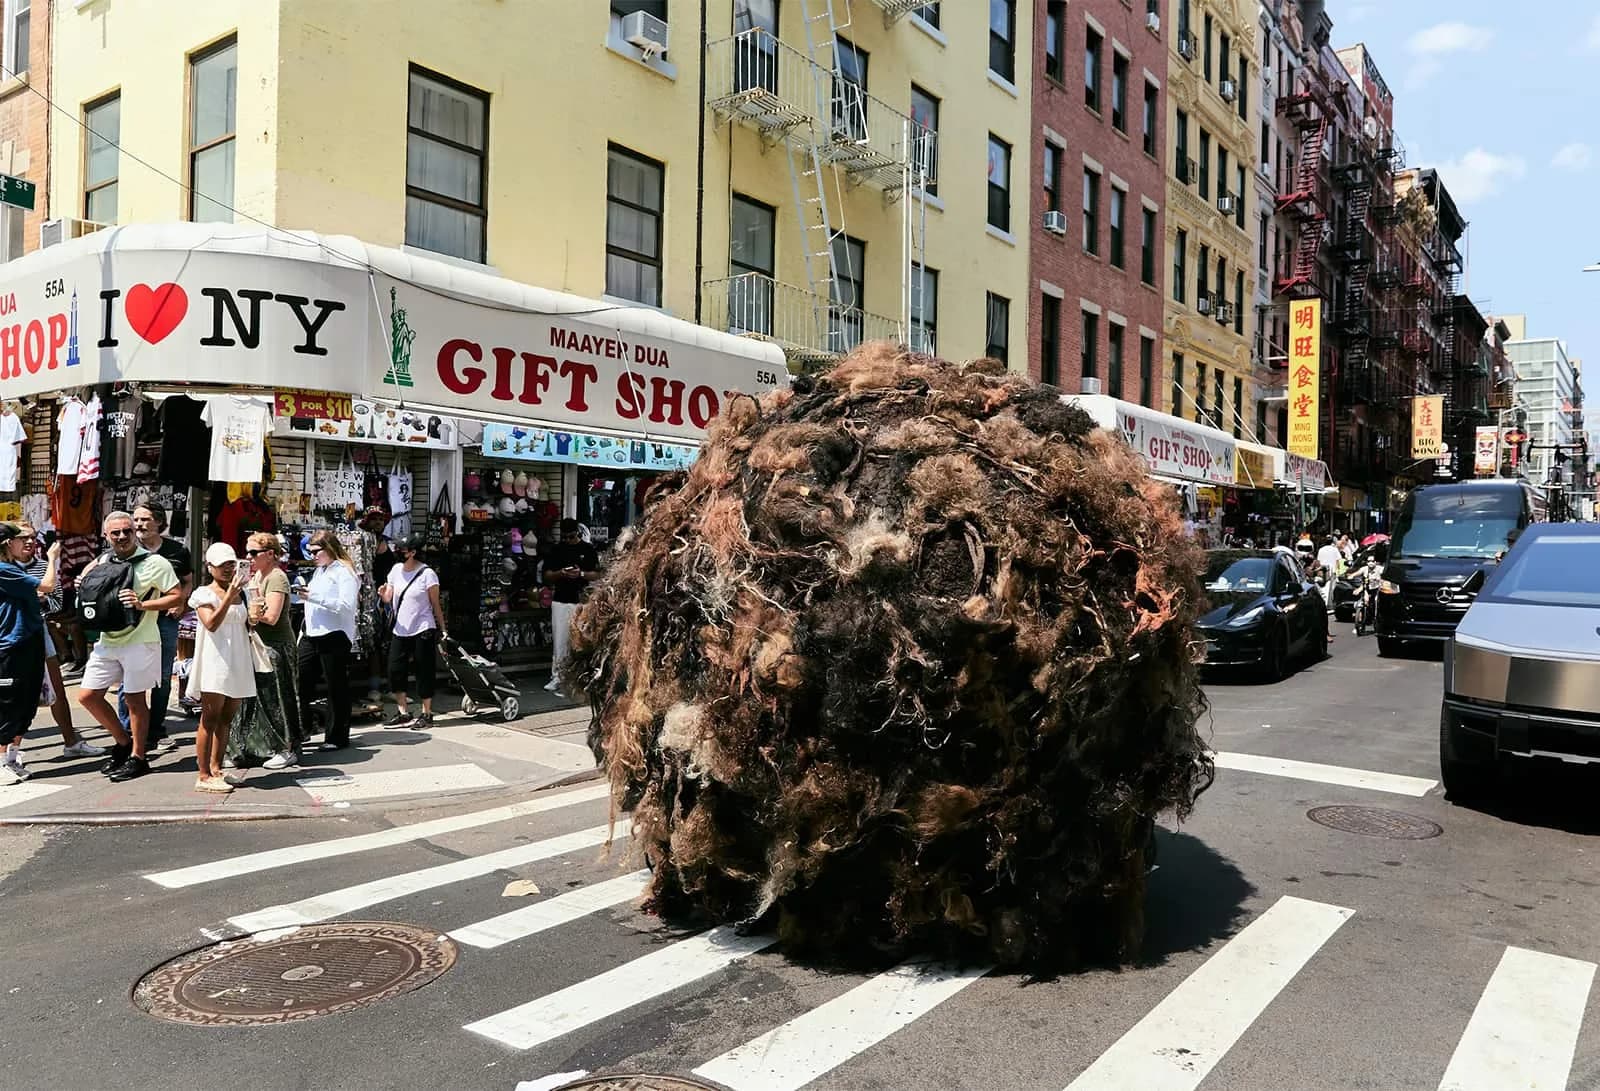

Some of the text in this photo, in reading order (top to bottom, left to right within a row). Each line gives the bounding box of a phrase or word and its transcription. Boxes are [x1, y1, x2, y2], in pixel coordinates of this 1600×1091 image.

[15, 181, 28, 191] St
[45, 278, 65, 298] 55A
[97, 287, 346, 356] I NY
[0, 313, 67, 380] HOP
[549, 326, 669, 369] MAAYER DUA
[1293, 305, 1315, 418] 明旺食堂
[436, 338, 734, 430] GIFT SHO
[756, 370, 777, 385] 55A
[279, 394, 352, 419] 3 FOR $10
[1124, 415, 1129, 430] I
[1294, 423, 1311, 431] MING
[1292, 434, 1312, 442] WONG
[1418, 438, 1435, 446] BIG
[1150, 437, 1180, 463] GIFT
[1183, 445, 1213, 470] SHOP
[1413, 447, 1440, 455] WONG
